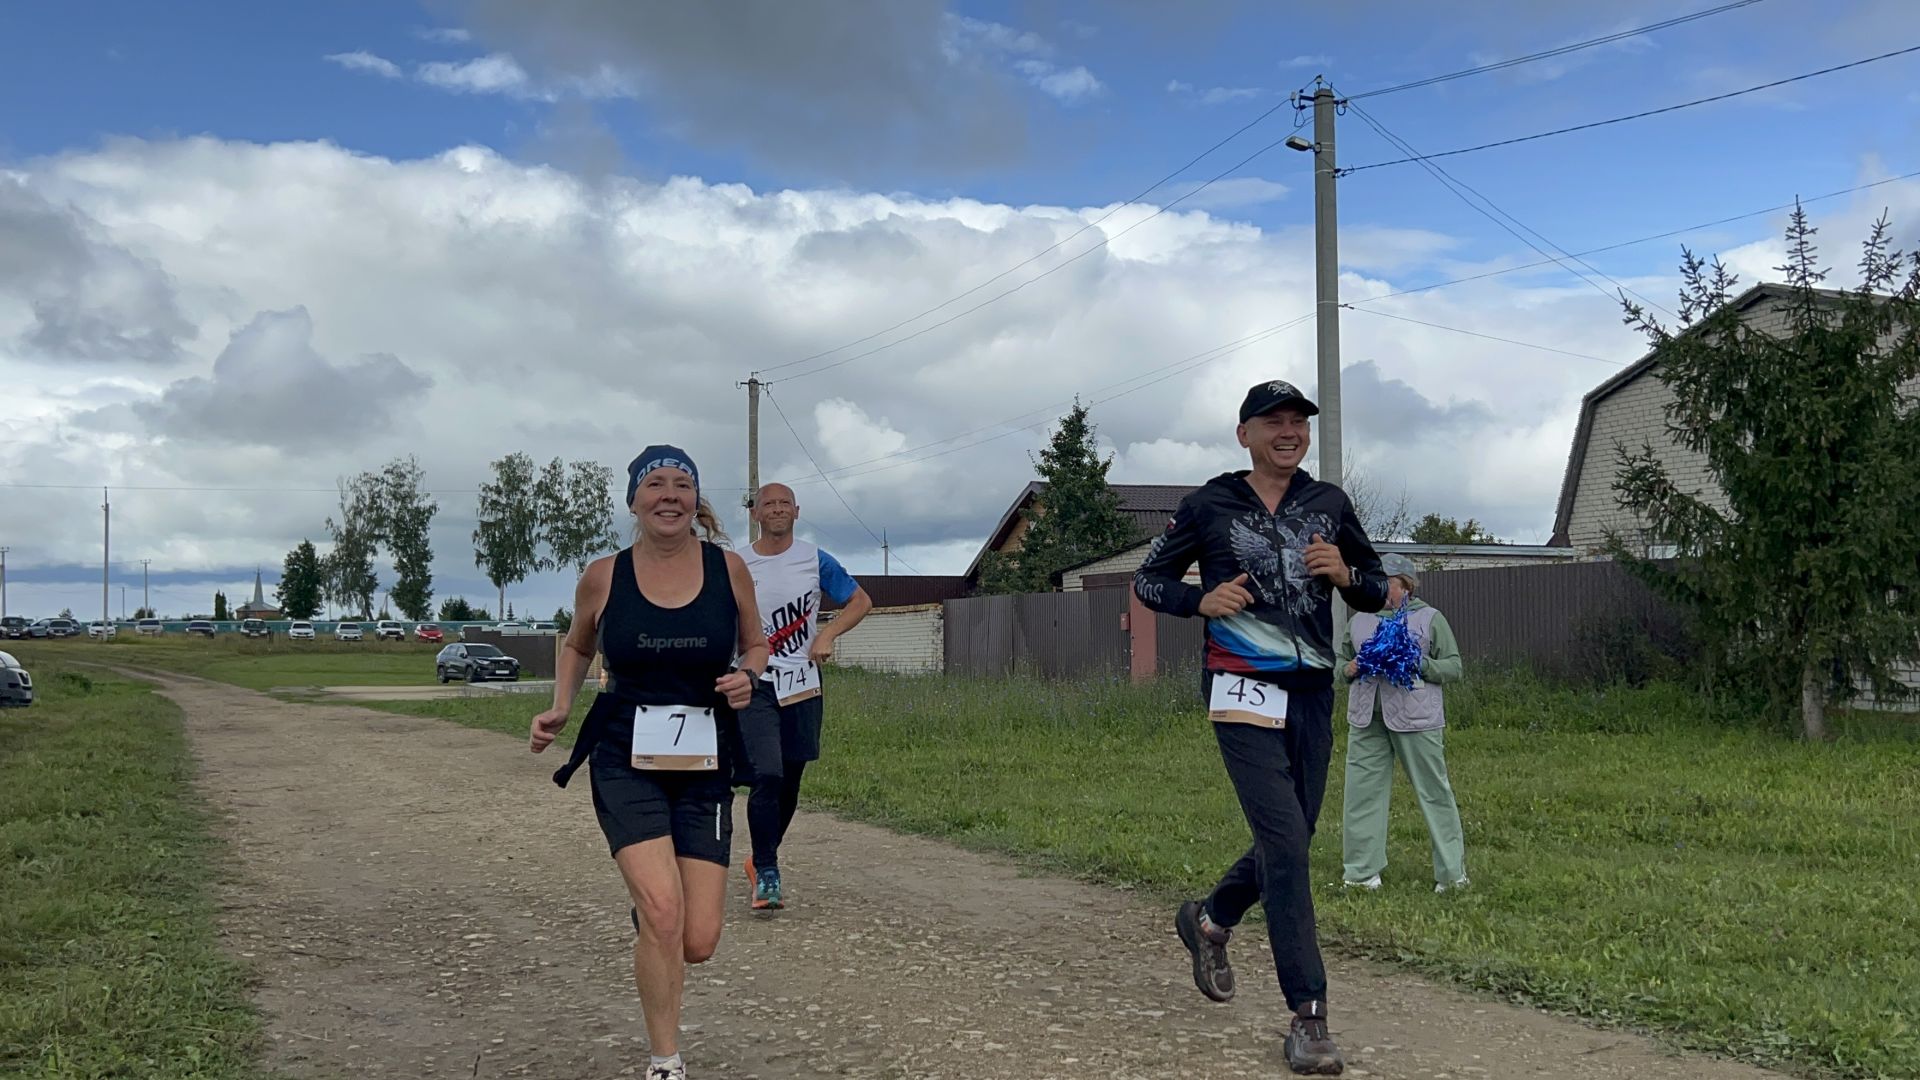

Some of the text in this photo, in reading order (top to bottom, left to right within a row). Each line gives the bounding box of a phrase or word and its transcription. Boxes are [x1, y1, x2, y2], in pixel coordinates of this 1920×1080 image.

[771, 590, 813, 632] ONE
[637, 633, 708, 653] Supreme
[774, 667, 807, 691] 174
[1227, 677, 1268, 706] 45
[667, 713, 687, 746] 7
